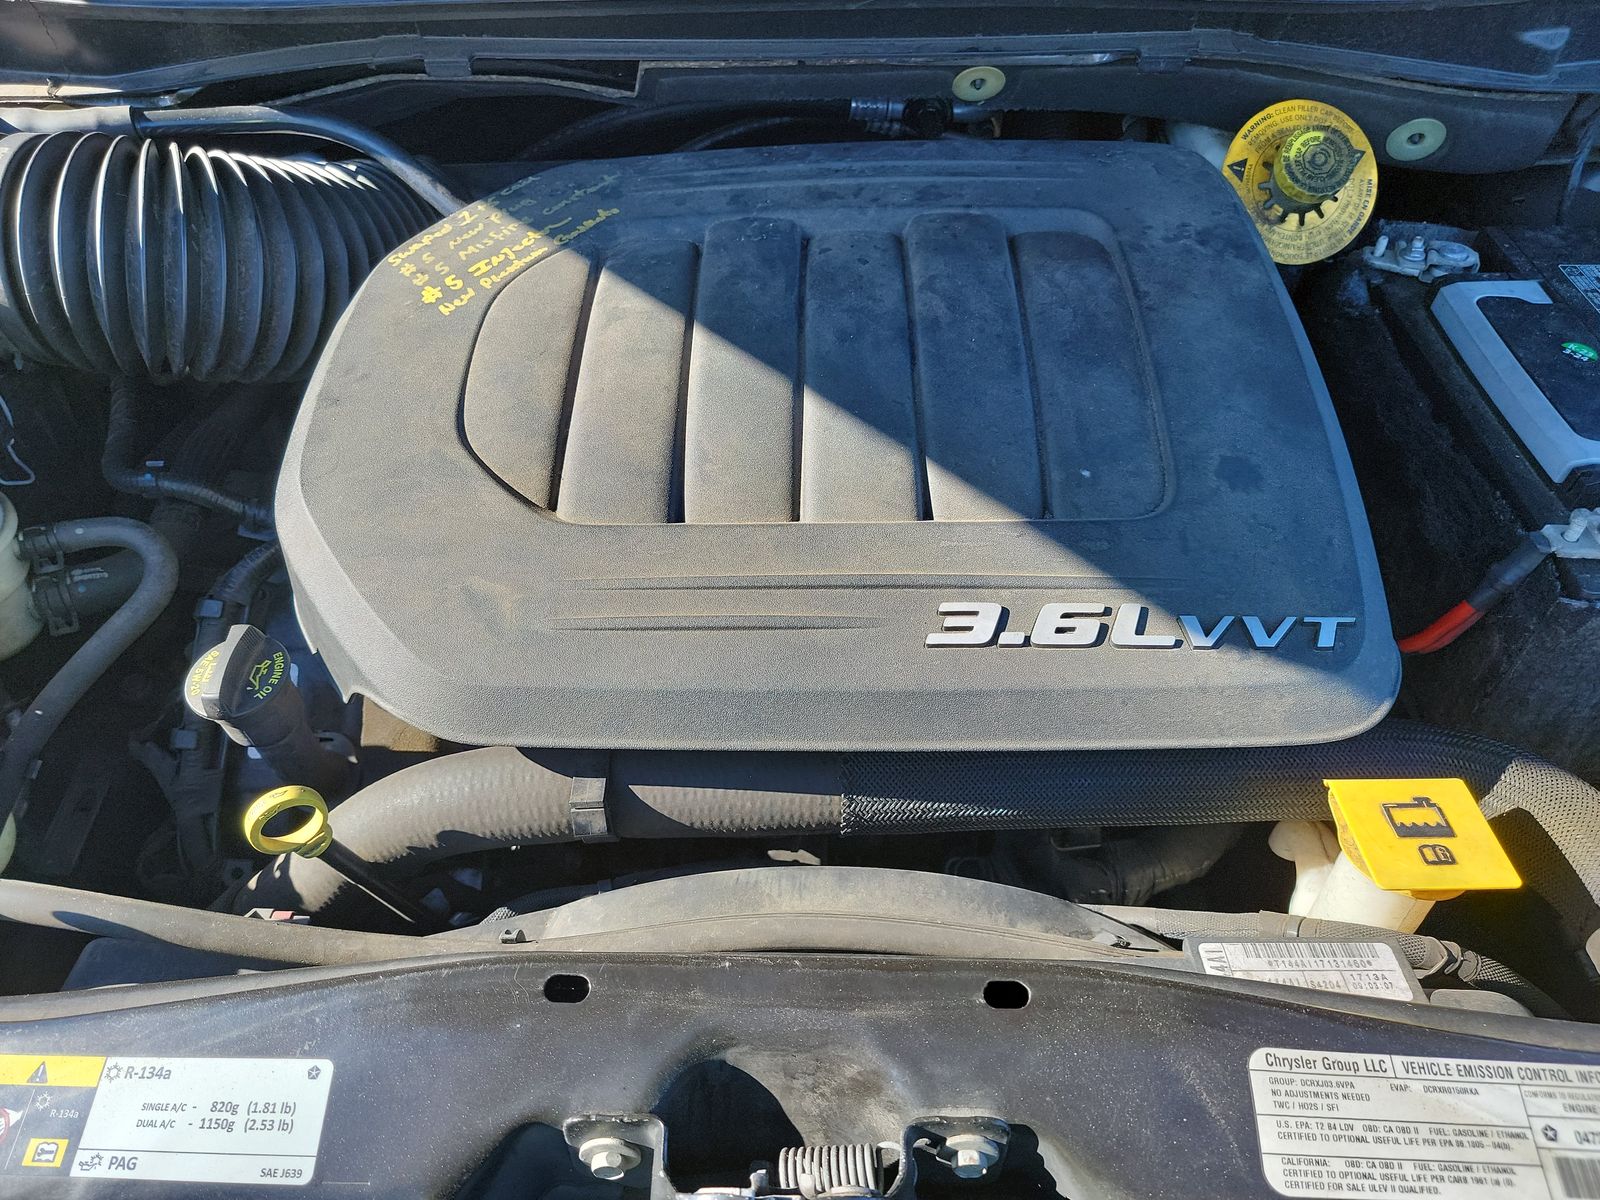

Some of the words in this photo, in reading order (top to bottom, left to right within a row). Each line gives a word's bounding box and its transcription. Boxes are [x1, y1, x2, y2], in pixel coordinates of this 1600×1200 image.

[1241, 113, 1274, 140] WARNING:
[1274, 105, 1296, 116] CLEAN
[1297, 105, 1318, 113] FILLER
[1280, 115, 1293, 124] USE
[925, 601, 1176, 648] 3.6L
[1178, 615, 1357, 651] VVT
[268, 652, 284, 685] ENGINE
[253, 686, 273, 700] OIL
[1265, 1052, 1317, 1071] Chrysler
[1321, 1056, 1360, 1074] Group
[1364, 1058, 1388, 1073] LLC
[124, 1064, 172, 1081] R-134a
[1401, 1060, 1453, 1076] VEHICLE
[1456, 1063, 1514, 1080] EMISSION
[1517, 1066, 1574, 1083] CONTROL
[1268, 1077, 1298, 1086] GROUP:
[1390, 1083, 1412, 1092] EVAP:
[1271, 1089, 1281, 1097] NO
[1284, 1090, 1339, 1100] ADJUSTMENTS
[1342, 1093, 1370, 1102] NEEDED
[49, 1109, 79, 1119] R-134a
[141, 1102, 170, 1112] SINGLE
[171, 1102, 187, 1113] A/C
[210, 1101, 240, 1115] 820g
[246, 1100, 277, 1116] (1.81
[280, 1101, 297, 1117] lb)
[1273, 1101, 1290, 1109] TWC
[1326, 1103, 1339, 1112] SFI
[136, 1119, 158, 1128] DUAL
[159, 1119, 176, 1129] A/C
[199, 1117, 235, 1133] 1150g
[244, 1117, 275, 1133] (2.53
[277, 1119, 294, 1134] lb)
[1276, 1119, 1292, 1129] U.S.
[1295, 1121, 1312, 1130] EPA:
[1315, 1121, 1325, 1130] T2
[1339, 1123, 1354, 1131] LDV
[1383, 1125, 1394, 1133] CA
[1428, 1127, 1451, 1136] FUEL:
[1452, 1128, 1489, 1138] GASOLINE
[1496, 1131, 1529, 1140] ETHANOL
[1277, 1132, 1317, 1141] CERTIFIED
[1320, 1133, 1330, 1141] TO
[1332, 1134, 1370, 1144] OPTIONAL
[1372, 1136, 1402, 1145] USEFUL
[1403, 1138, 1420, 1146] LIFE
[1422, 1138, 1437, 1147] PER
[1439, 1139, 1454, 1148] EPA
[107, 1155, 138, 1171] PAG
[1281, 1156, 1331, 1167] CALIFORNIA:
[1366, 1160, 1377, 1169] CA
[1413, 1162, 1435, 1171] FUEL:
[1437, 1163, 1475, 1173] GASOLINE
[1482, 1165, 1516, 1175] ETHANOL
[260, 1168, 278, 1178] SAE
[280, 1168, 303, 1178] J639
[1282, 1168, 1323, 1179] CERTIFIED
[1326, 1170, 1336, 1179] TO
[1338, 1171, 1377, 1181] OPTIONAL
[1379, 1172, 1409, 1182] USEFUL
[1411, 1174, 1428, 1183] LIFE
[1430, 1174, 1445, 1183] PER
[1284, 1180, 1325, 1191] CERTIFIED
[1327, 1182, 1344, 1191] FOR
[1346, 1183, 1366, 1192] SALE
[1368, 1184, 1388, 1193] ULEV
[1398, 1185, 1441, 1195] QUALIFIED.
